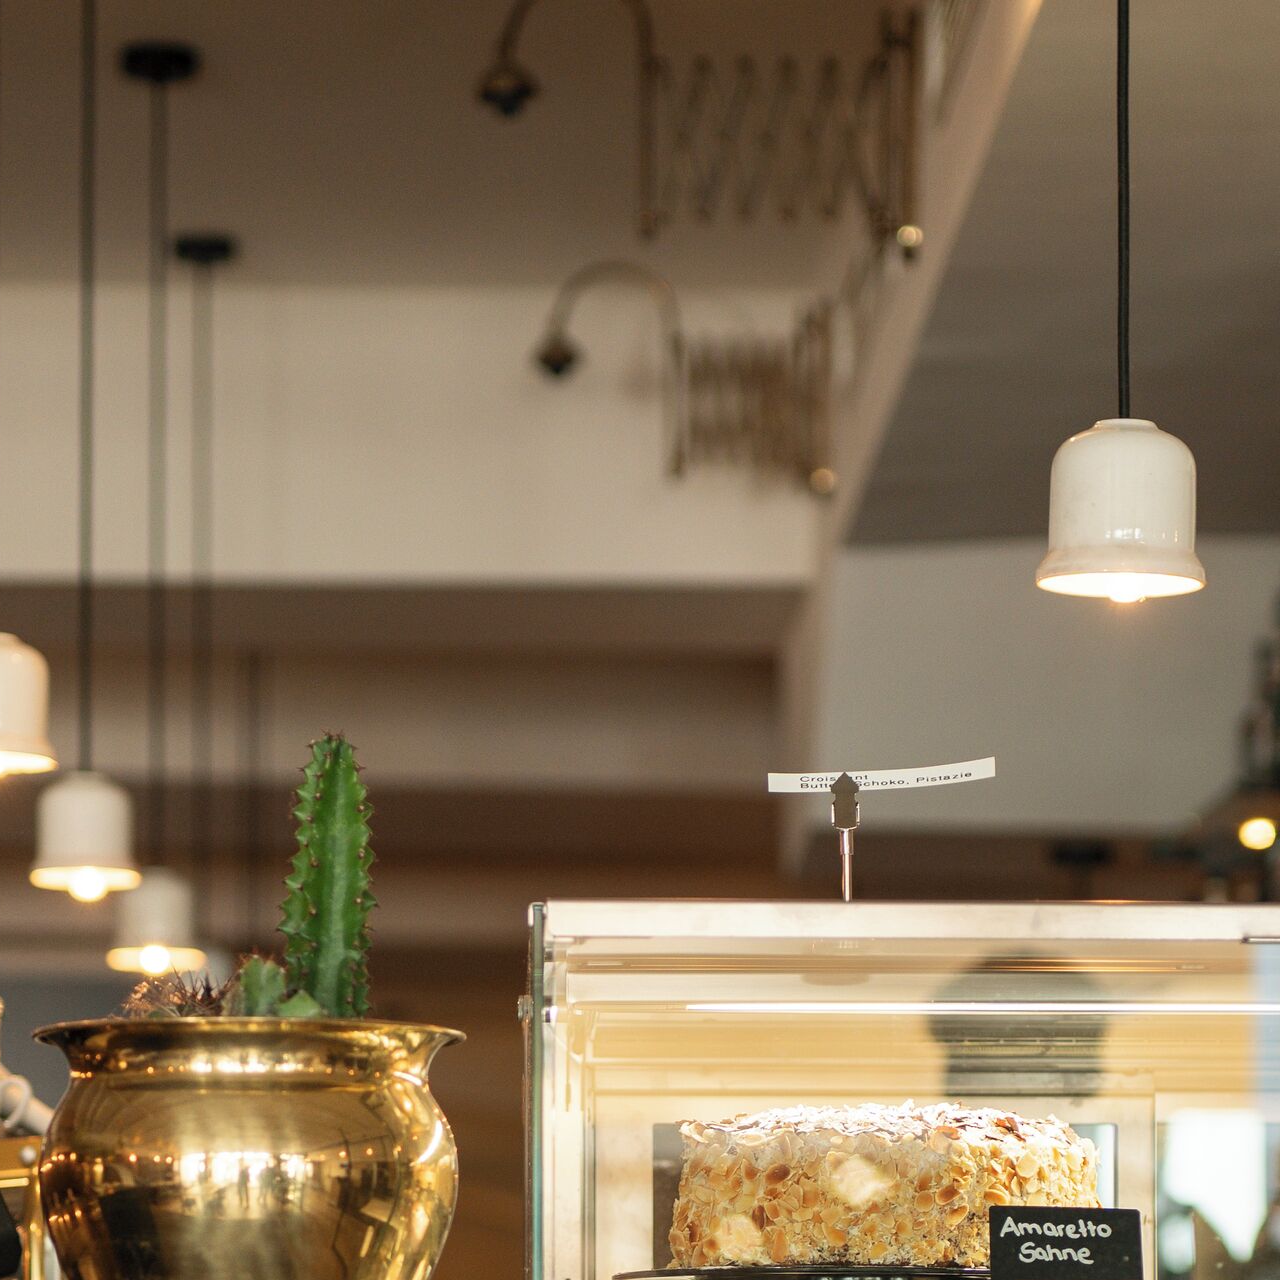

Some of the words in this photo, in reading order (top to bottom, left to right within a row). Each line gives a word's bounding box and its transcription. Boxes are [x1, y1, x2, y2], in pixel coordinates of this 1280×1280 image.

[800, 774, 868, 782] Croisnt
[916, 771, 972, 783] Pistazie
[1000, 1216, 1112, 1239] Amaretto
[1019, 1241, 1094, 1265] Sahne
